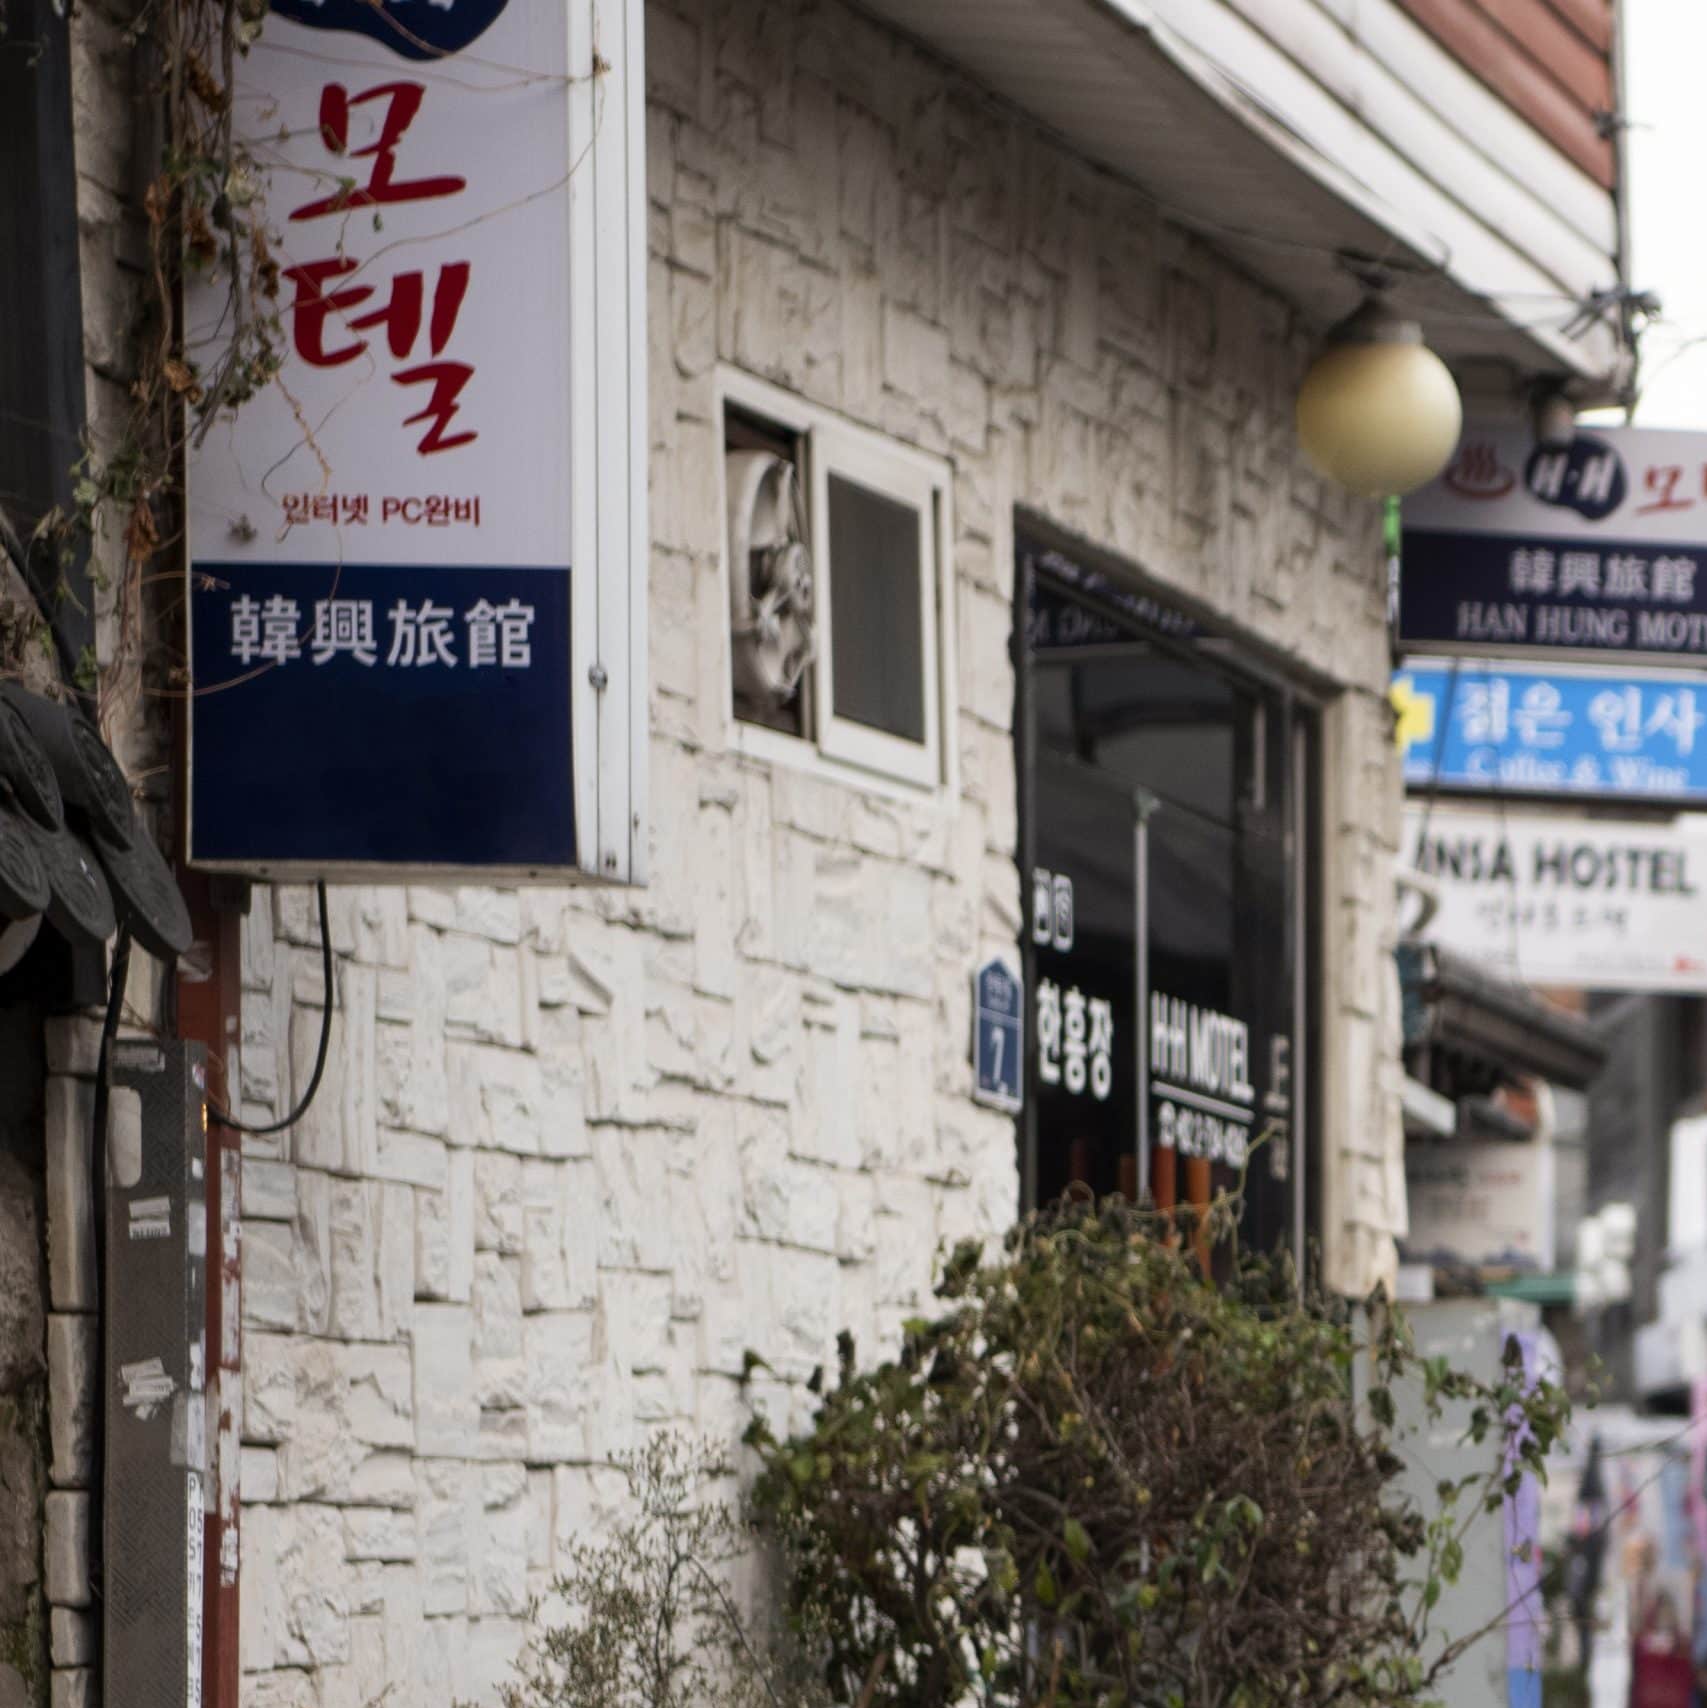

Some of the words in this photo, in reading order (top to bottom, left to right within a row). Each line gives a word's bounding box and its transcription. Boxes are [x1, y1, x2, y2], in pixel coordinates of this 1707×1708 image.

[280, 81, 480, 456] 모텔
[282, 494, 369, 526] 인터넷
[382, 495, 481, 527] PC완비
[1510, 547, 1697, 603] 韓興旅館
[231, 595, 536, 669] 韓興旅館
[1456, 600, 1528, 639] HAN
[1535, 605, 1630, 645] HUNG
[1533, 842, 1699, 897] HOSTEL
